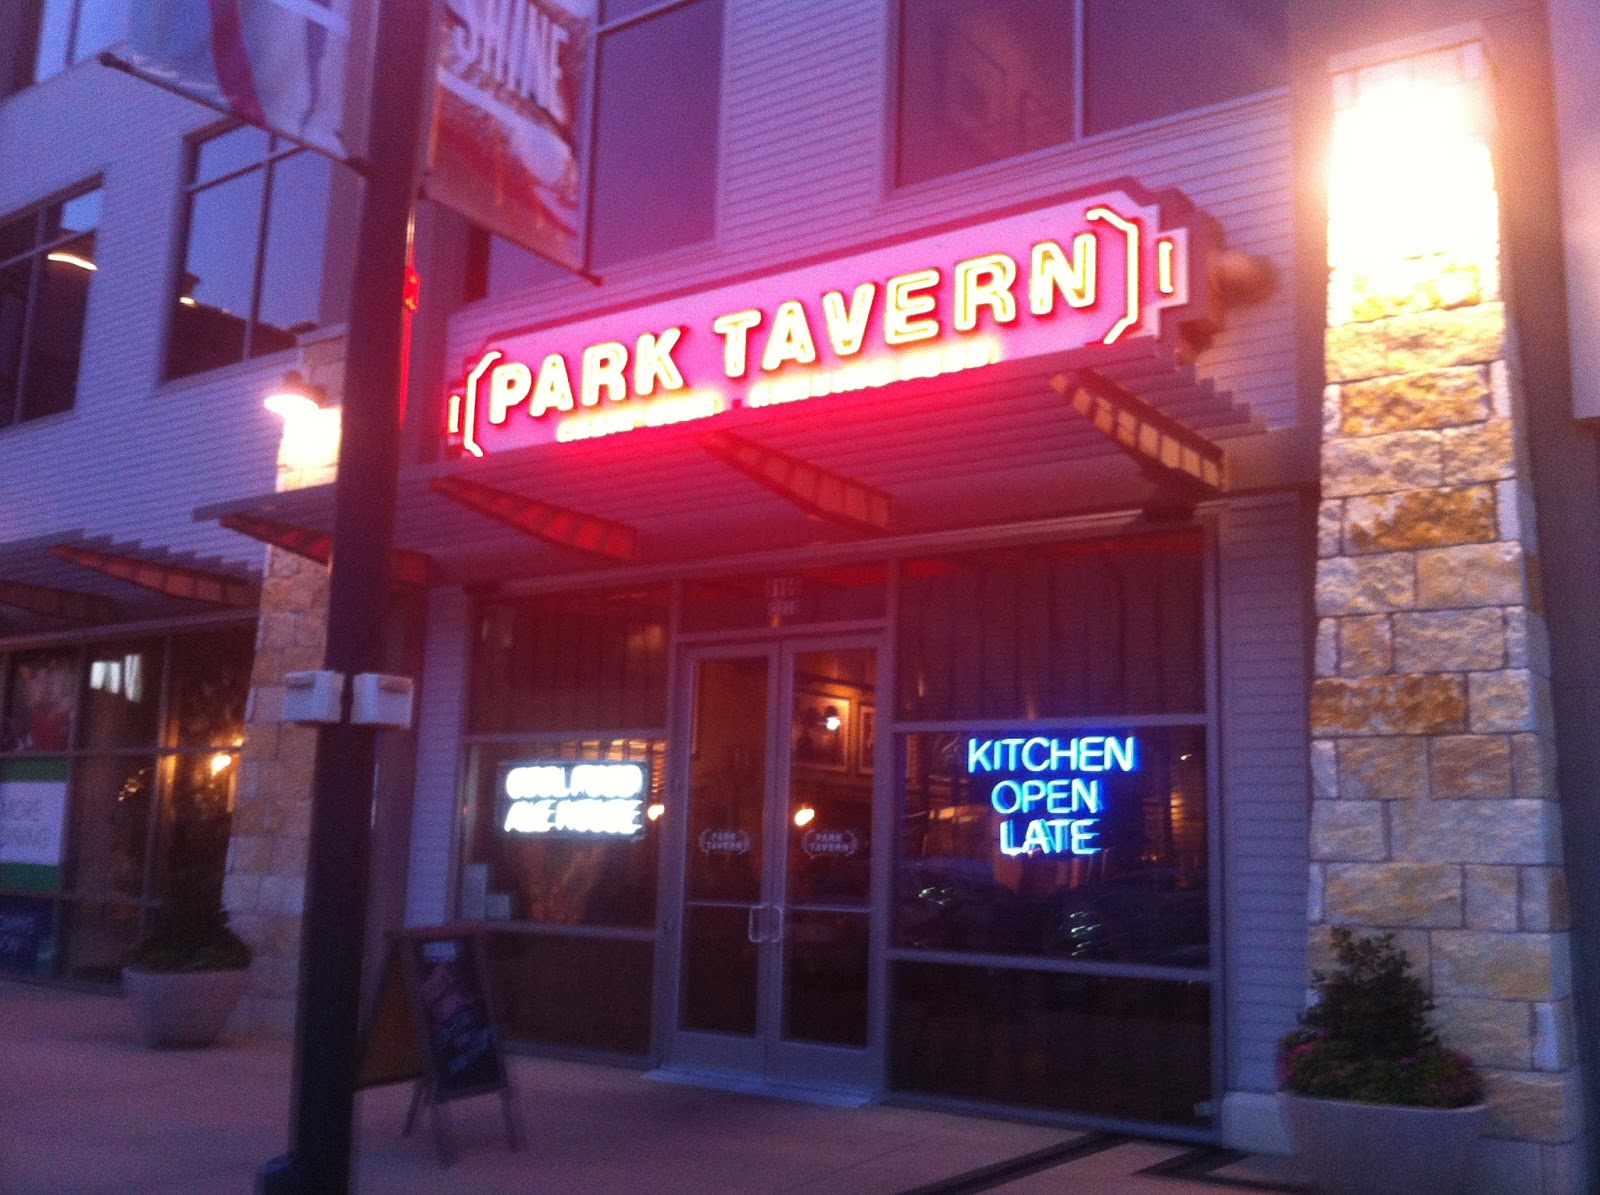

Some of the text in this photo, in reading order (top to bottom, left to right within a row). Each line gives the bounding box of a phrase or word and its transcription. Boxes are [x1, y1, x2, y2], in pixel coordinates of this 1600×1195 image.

[487, 326, 685, 425] PARK
[713, 231, 1097, 378] TAVERN
[967, 735, 1136, 774] KITCHEN
[991, 778, 1099, 814] OPEN
[706, 841, 743, 850] TAVERN
[711, 832, 737, 841] PARK
[809, 842, 850, 852] TAVERN
[815, 832, 843, 842] PARK
[1000, 818, 1102, 856] LATE
